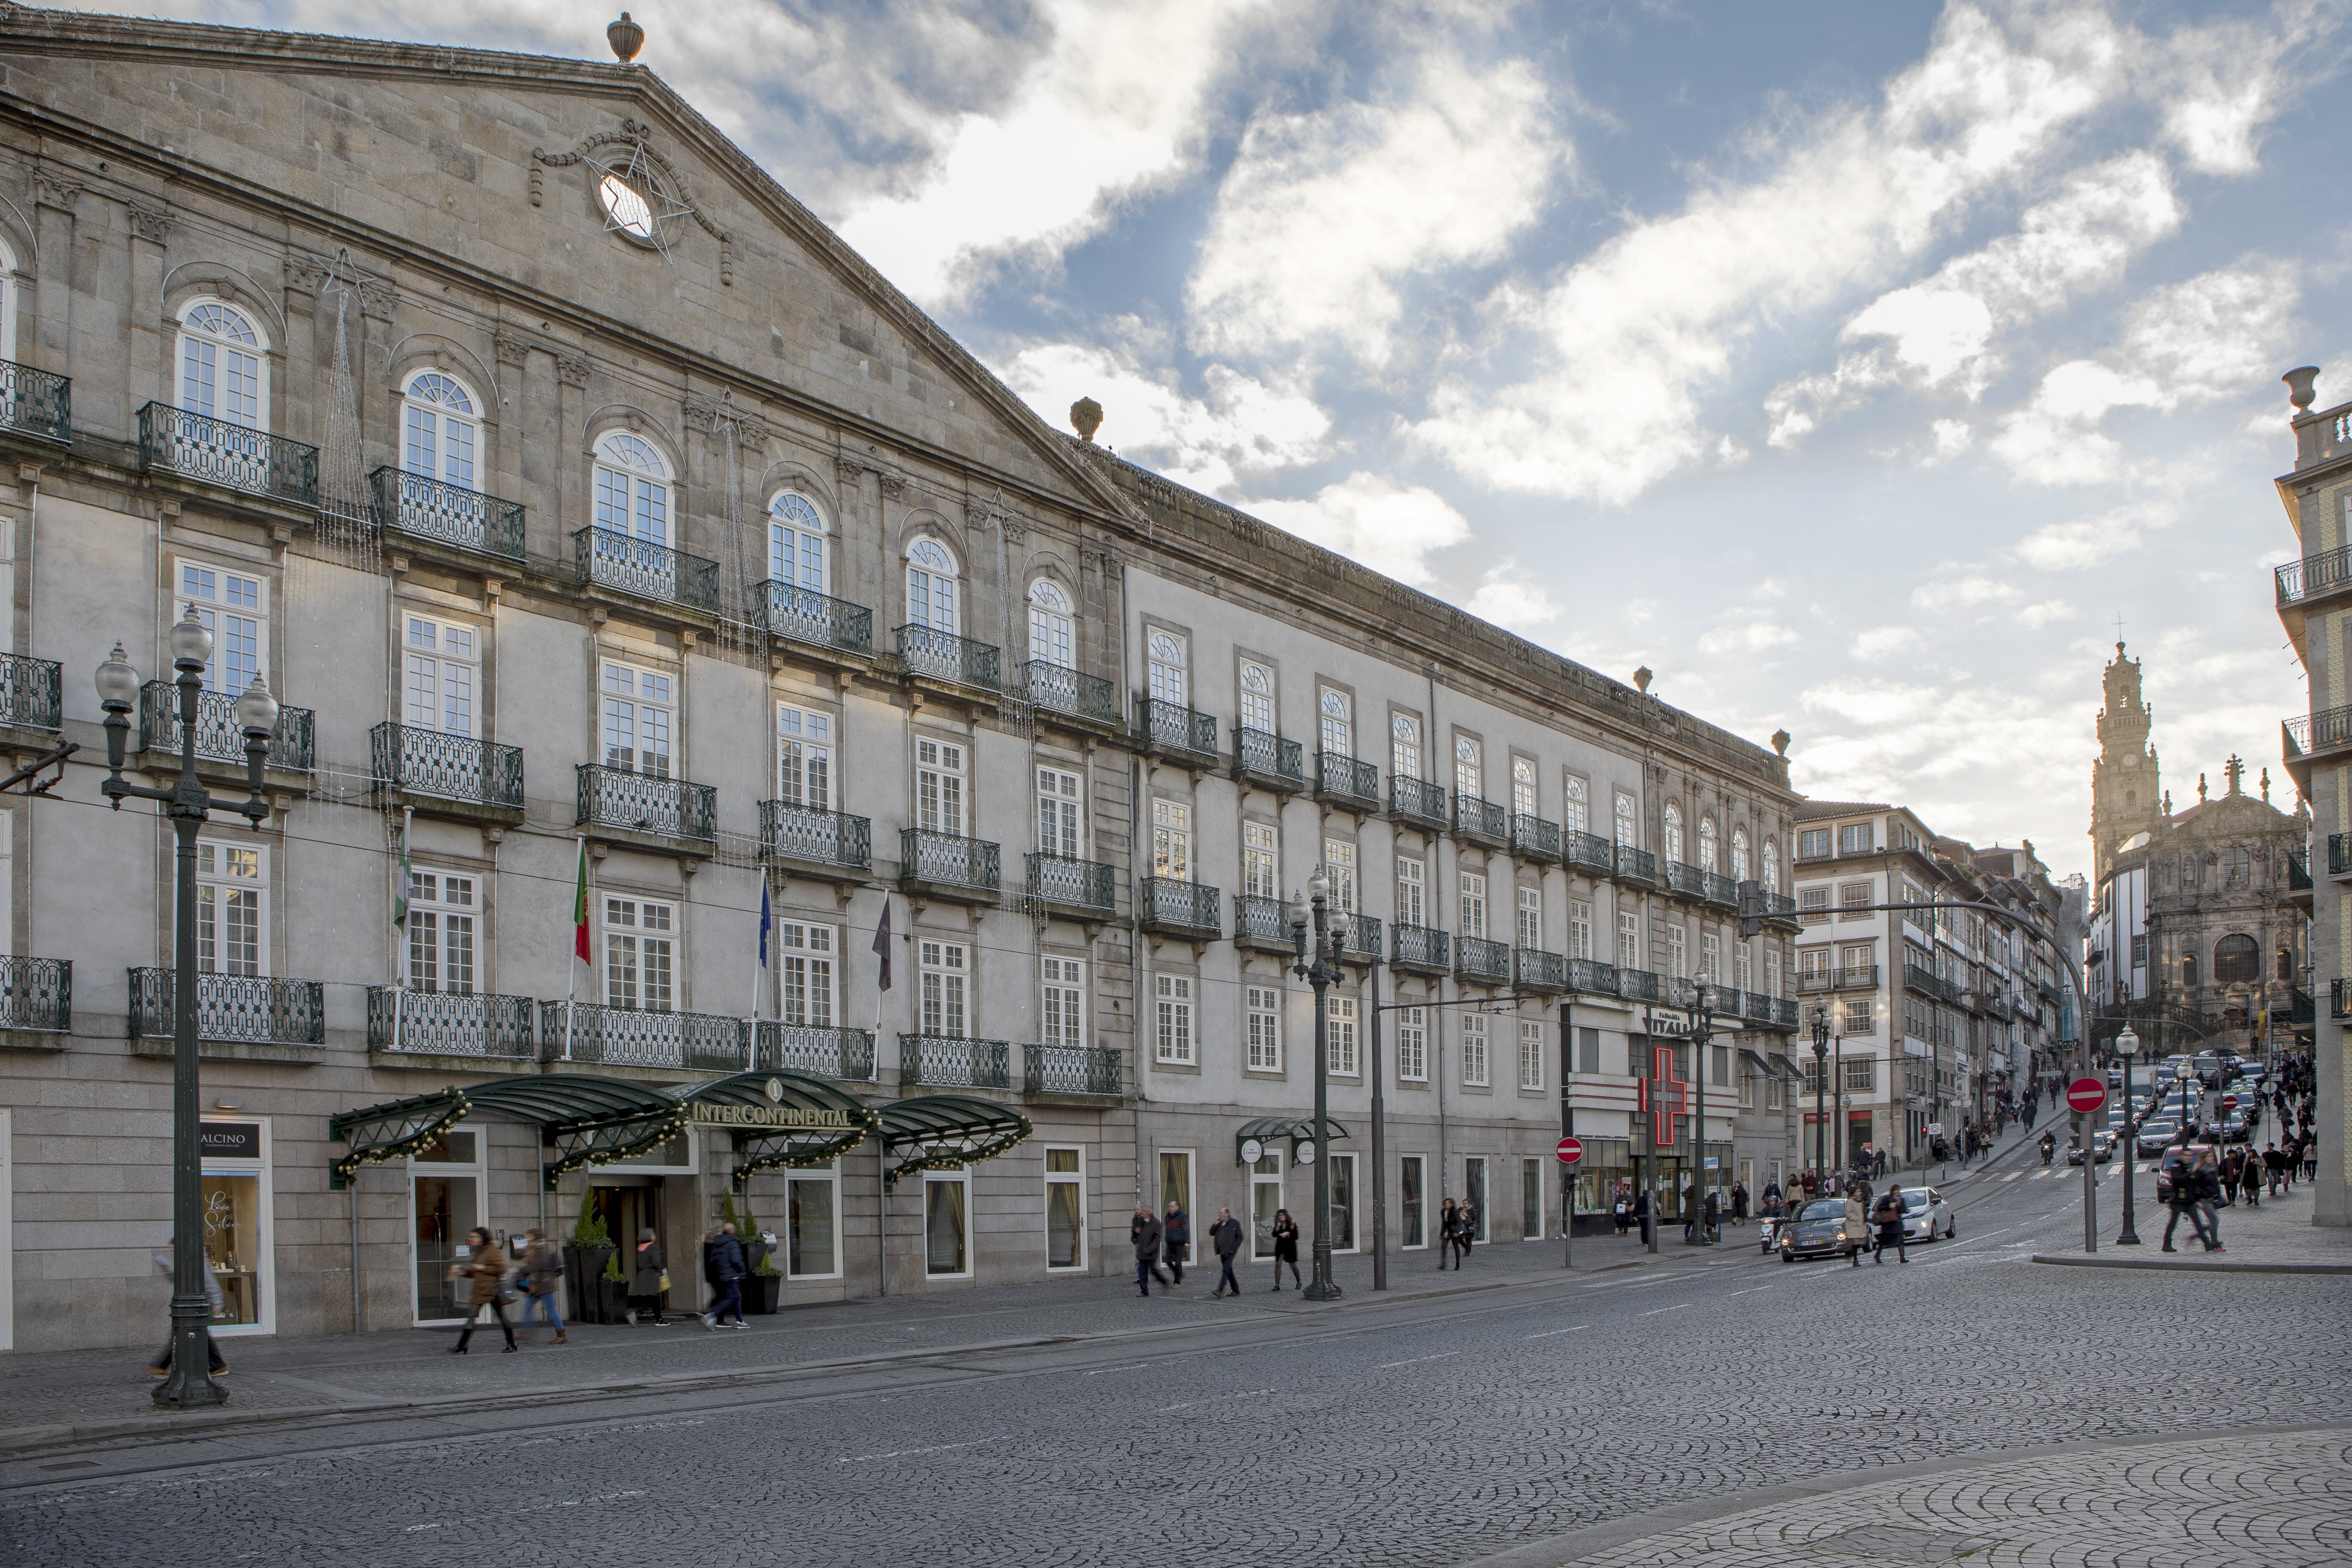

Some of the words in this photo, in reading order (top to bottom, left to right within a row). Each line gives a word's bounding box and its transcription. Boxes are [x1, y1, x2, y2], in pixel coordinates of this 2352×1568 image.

[1642, 1017, 1689, 1035] VITÁLI
[201, 1134, 245, 1144] ALCINO
[205, 1191, 231, 1212] Love
[204, 1211, 242, 1237] Silver
